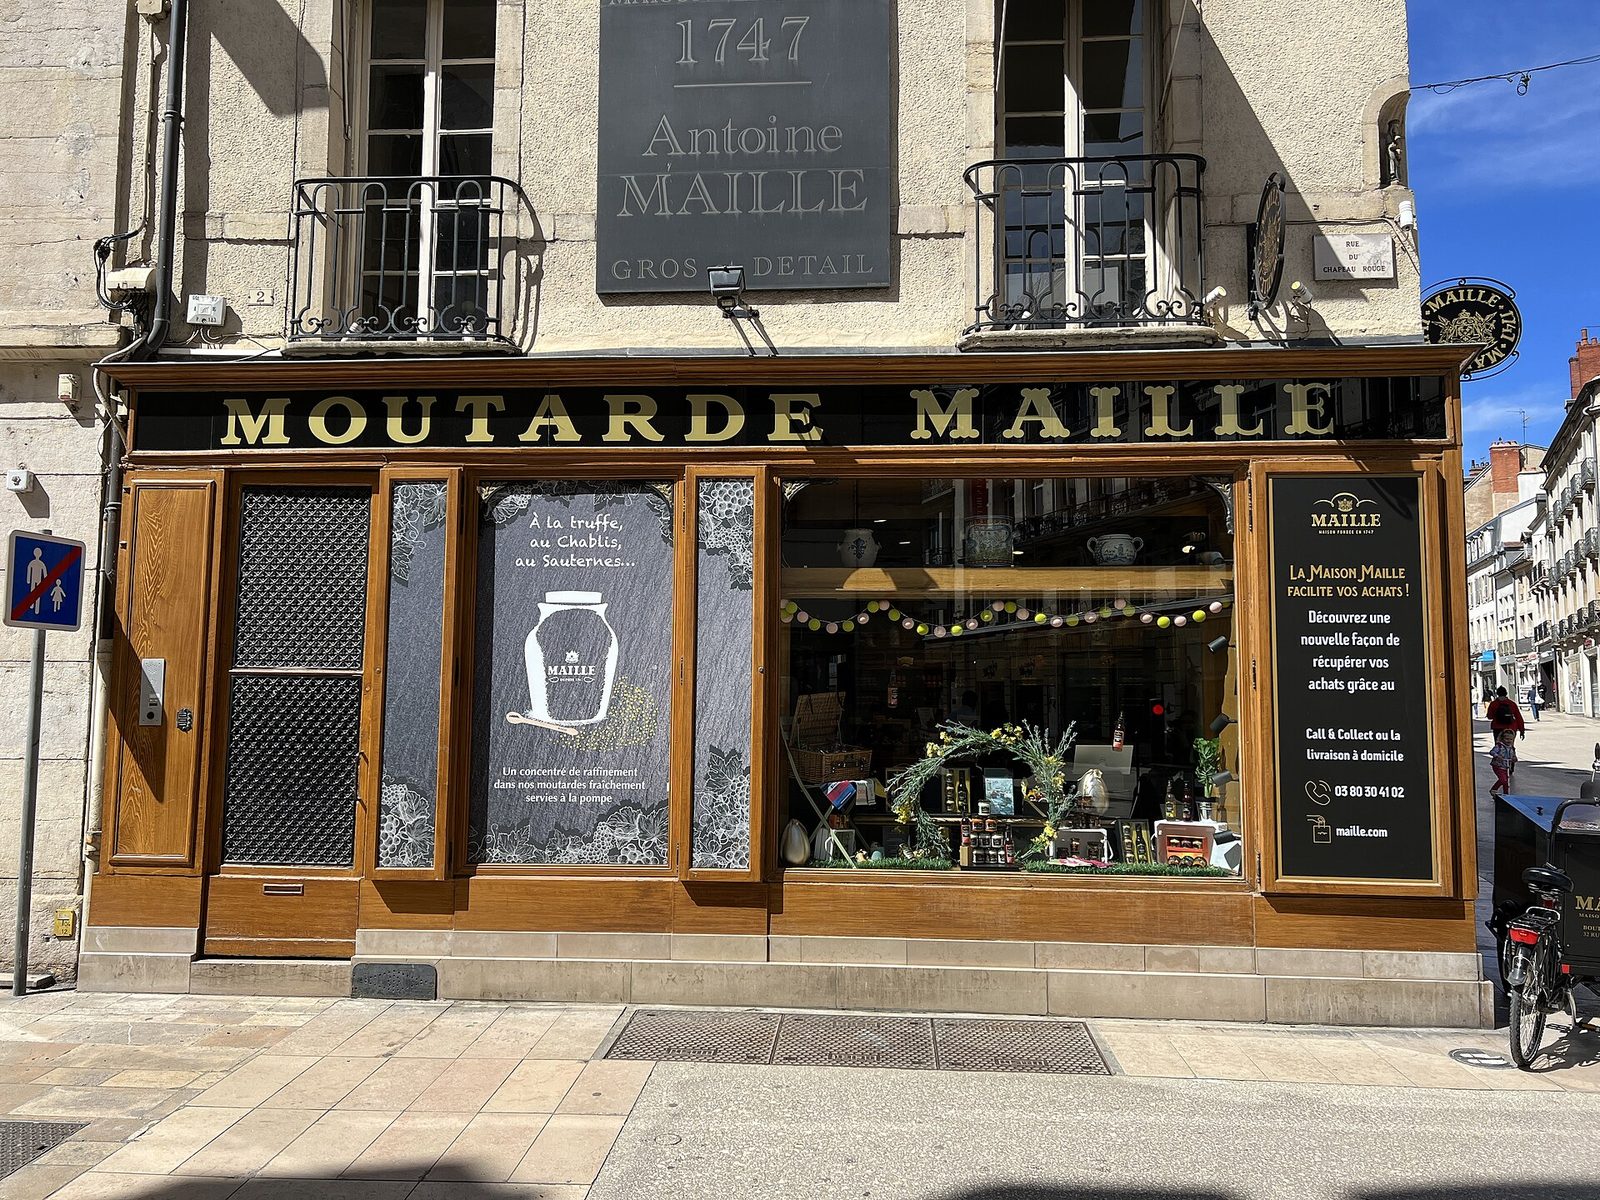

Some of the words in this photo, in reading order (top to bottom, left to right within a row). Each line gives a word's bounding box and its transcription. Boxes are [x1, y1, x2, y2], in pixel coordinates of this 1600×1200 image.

[676, 16, 810, 64] 1747
[642, 114, 844, 156] Antoine
[616, 169, 868, 217] MAILLE
[1345, 240, 1360, 248] RUE
[611, 258, 698, 280] GROS
[753, 254, 873, 277] DETAIL
[256, 291, 265, 303] 2
[1426, 289, 1501, 312] MAILLE
[1500, 310, 1516, 342] 1747
[220, 393, 824, 445] MOUTARDE
[909, 382, 1335, 440] MAILLE
[529, 512, 540, 529] À
[547, 515, 563, 529] la
[570, 513, 623, 532] truffe,
[1311, 513, 1381, 527] MAILLE
[530, 538, 551, 548] au
[557, 535, 622, 551] Chablis,
[515, 558, 536, 567] au
[543, 554, 635, 567] Sauternes...
[1287, 586, 1333, 597] FACILITE
[1337, 586, 1358, 597] VOS
[1308, 610, 1367, 624] Découvrez
[1369, 613, 1391, 624] une
[1300, 632, 1350, 646] nouvelle
[1351, 632, 1384, 648] façon
[1386, 633, 1400, 646] de
[1312, 655, 1367, 671] récupérer
[1369, 658, 1389, 669] vos
[548, 665, 596, 676] MAILLE
[1308, 677, 1345, 690] achats
[1347, 678, 1378, 694] grâce
[1380, 681, 1395, 691] au
[1306, 728, 1326, 740] Call
[1328, 729, 1336, 740] &
[1337, 728, 1374, 741] Collect
[1375, 731, 1388, 741] ou
[1390, 729, 1401, 741] la
[1306, 749, 1350, 761] livraison
[1352, 749, 1359, 761] à
[1360, 750, 1404, 762] domicile
[502, 767, 517, 776] Un
[519, 766, 567, 776] concentré
[569, 767, 581, 776] de
[583, 767, 638, 777] raffinement
[494, 779, 516, 789] dans
[518, 781, 535, 789] nos
[537, 779, 587, 789] moutardes
[589, 780, 645, 790] fraîchement
[1334, 785, 1348, 797] 03
[1349, 786, 1363, 797] 80
[1364, 786, 1377, 798] 30
[1391, 786, 1405, 798] 02
[525, 794, 558, 802] servies
[559, 793, 566, 802] à
[568, 793, 577, 802] la
[579, 795, 613, 805] pompe
[1336, 826, 1388, 838] maille.com
